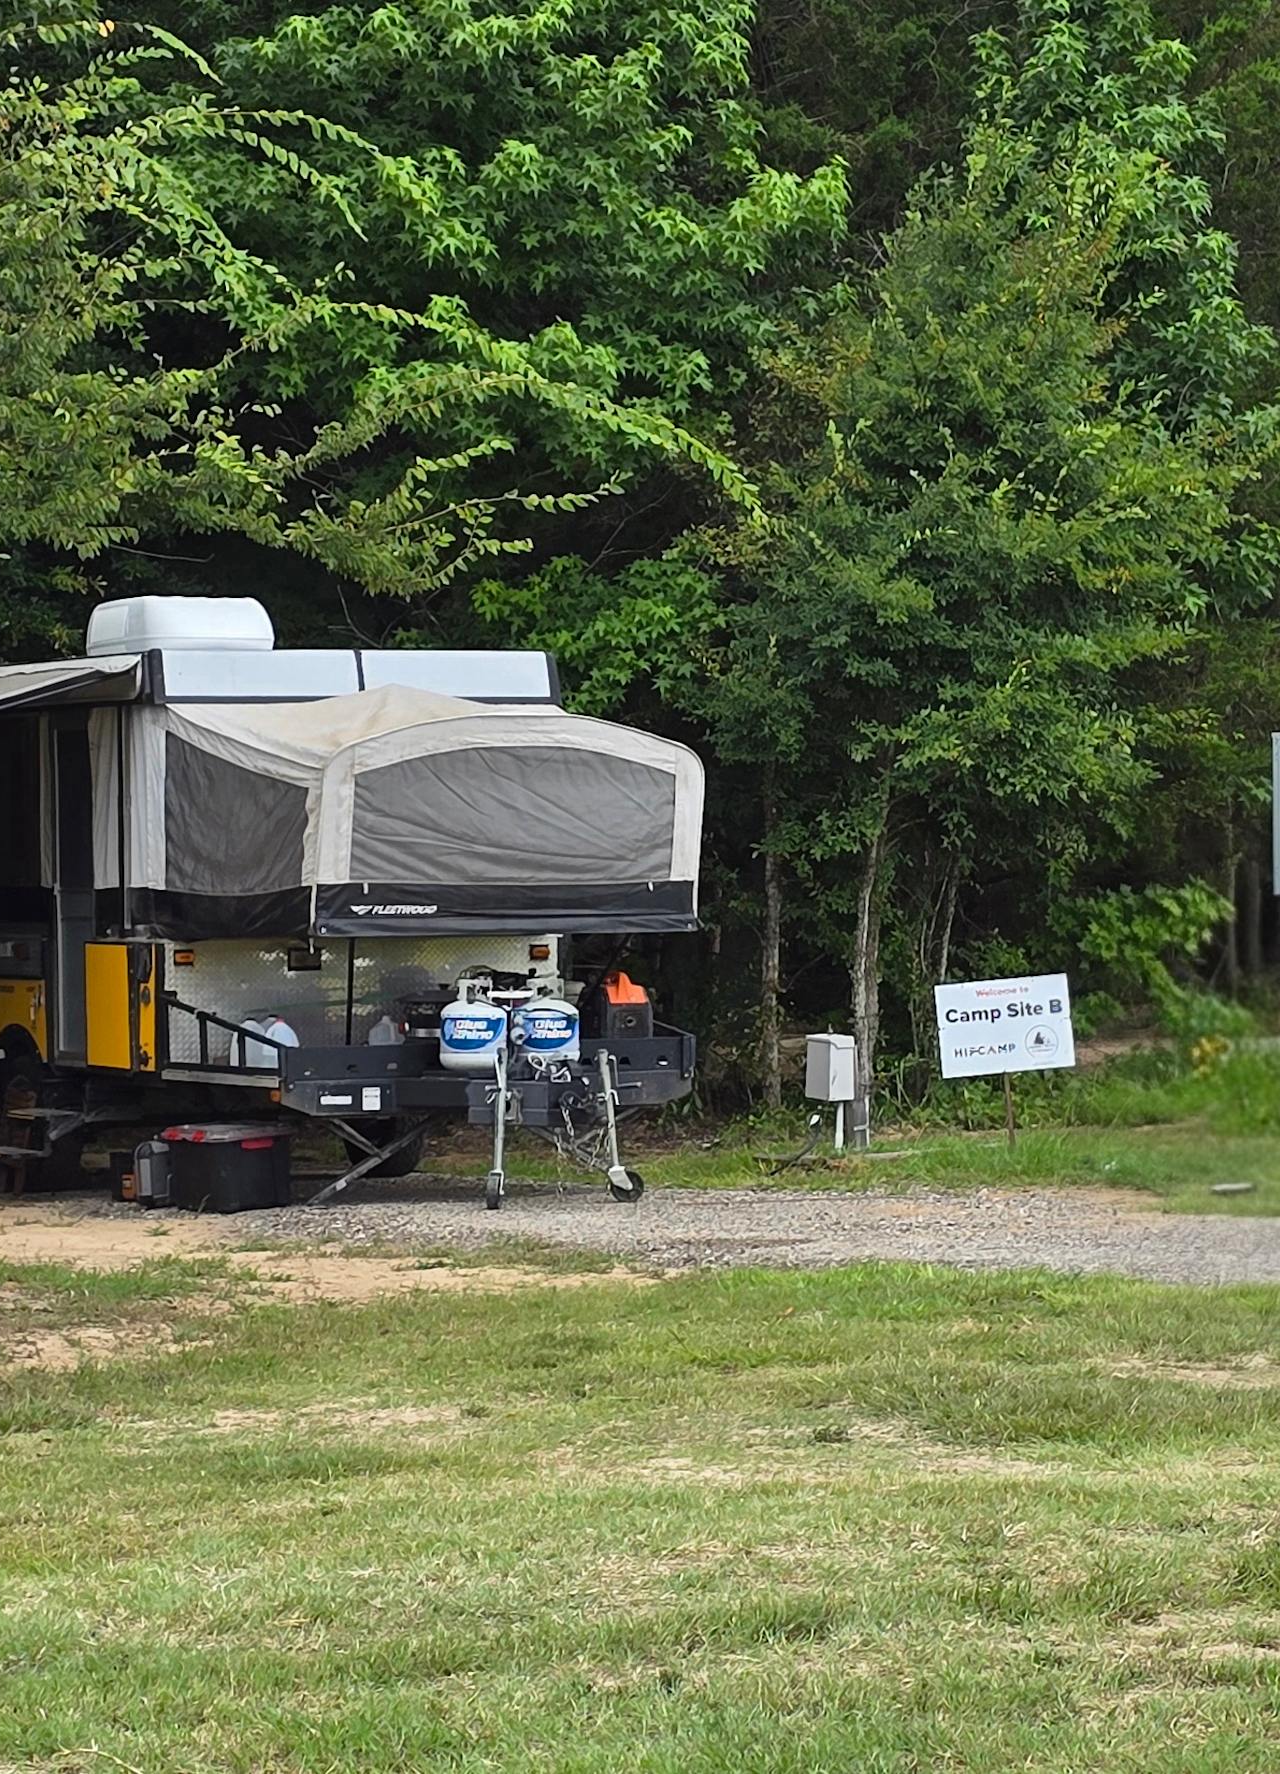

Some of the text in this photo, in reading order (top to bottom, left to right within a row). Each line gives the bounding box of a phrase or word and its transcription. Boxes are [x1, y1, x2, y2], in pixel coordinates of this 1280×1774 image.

[945, 999, 1063, 1024] Camp Site B
[954, 1043, 1016, 1058] HIPCAMP
